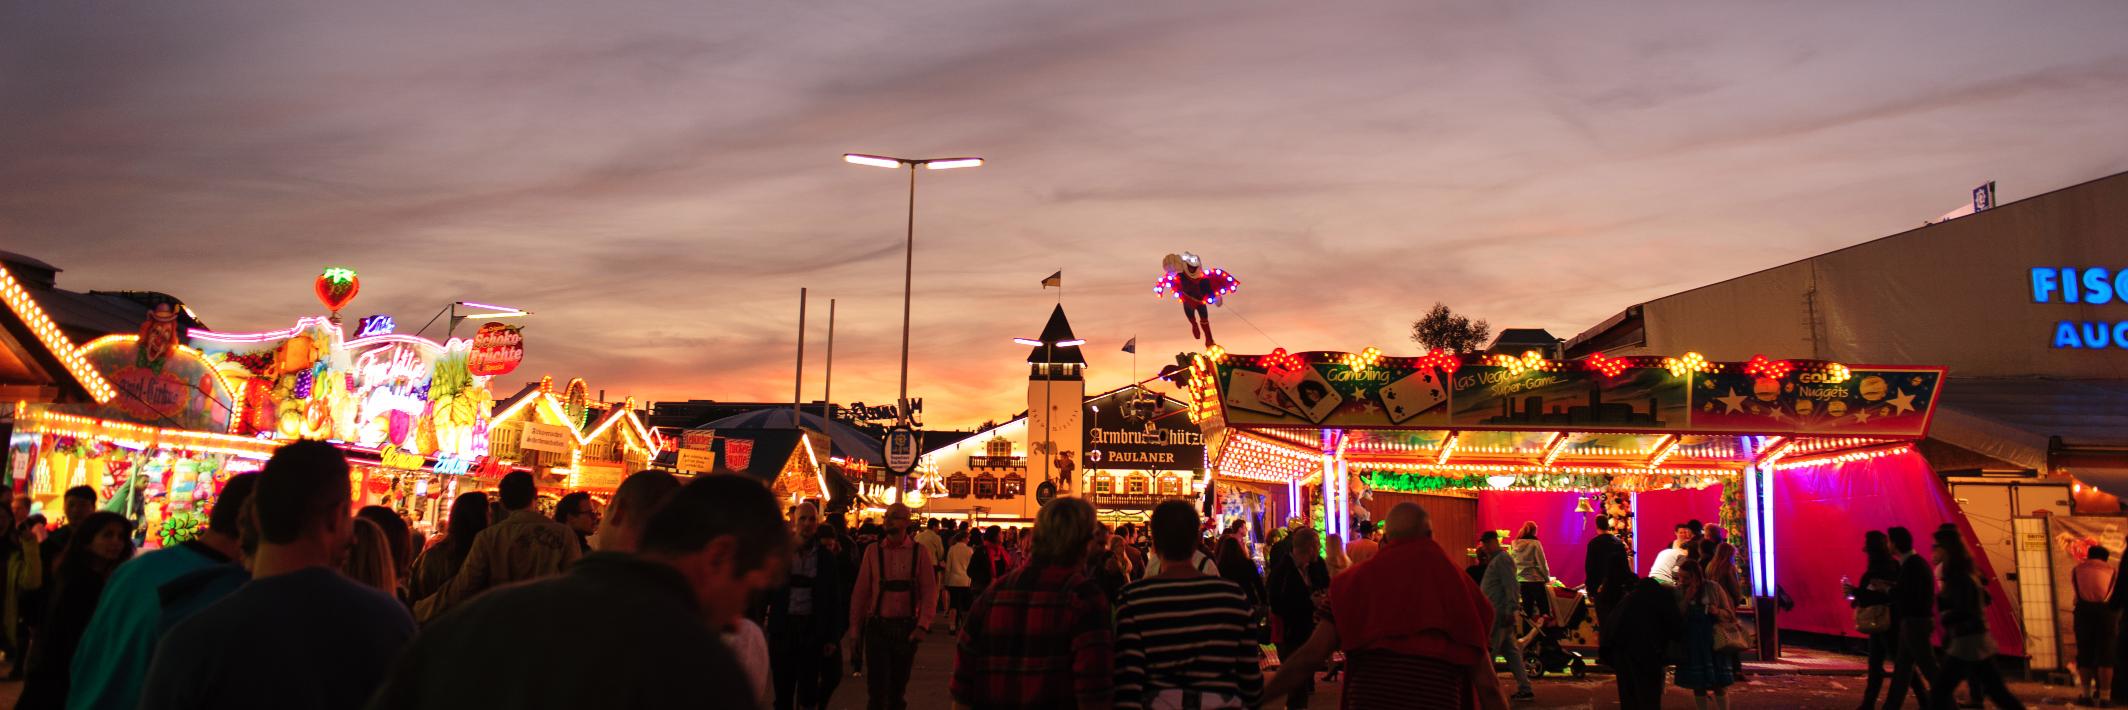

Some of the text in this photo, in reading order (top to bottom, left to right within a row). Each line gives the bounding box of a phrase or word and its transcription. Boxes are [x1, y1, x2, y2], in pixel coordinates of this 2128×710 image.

[475, 330, 522, 348] Schoko-
[468, 346, 522, 366] Früchte
[1453, 368, 1520, 391] Las Vega
[1800, 386, 1849, 401] Nuggets
[1108, 450, 1175, 463] PAULANER
